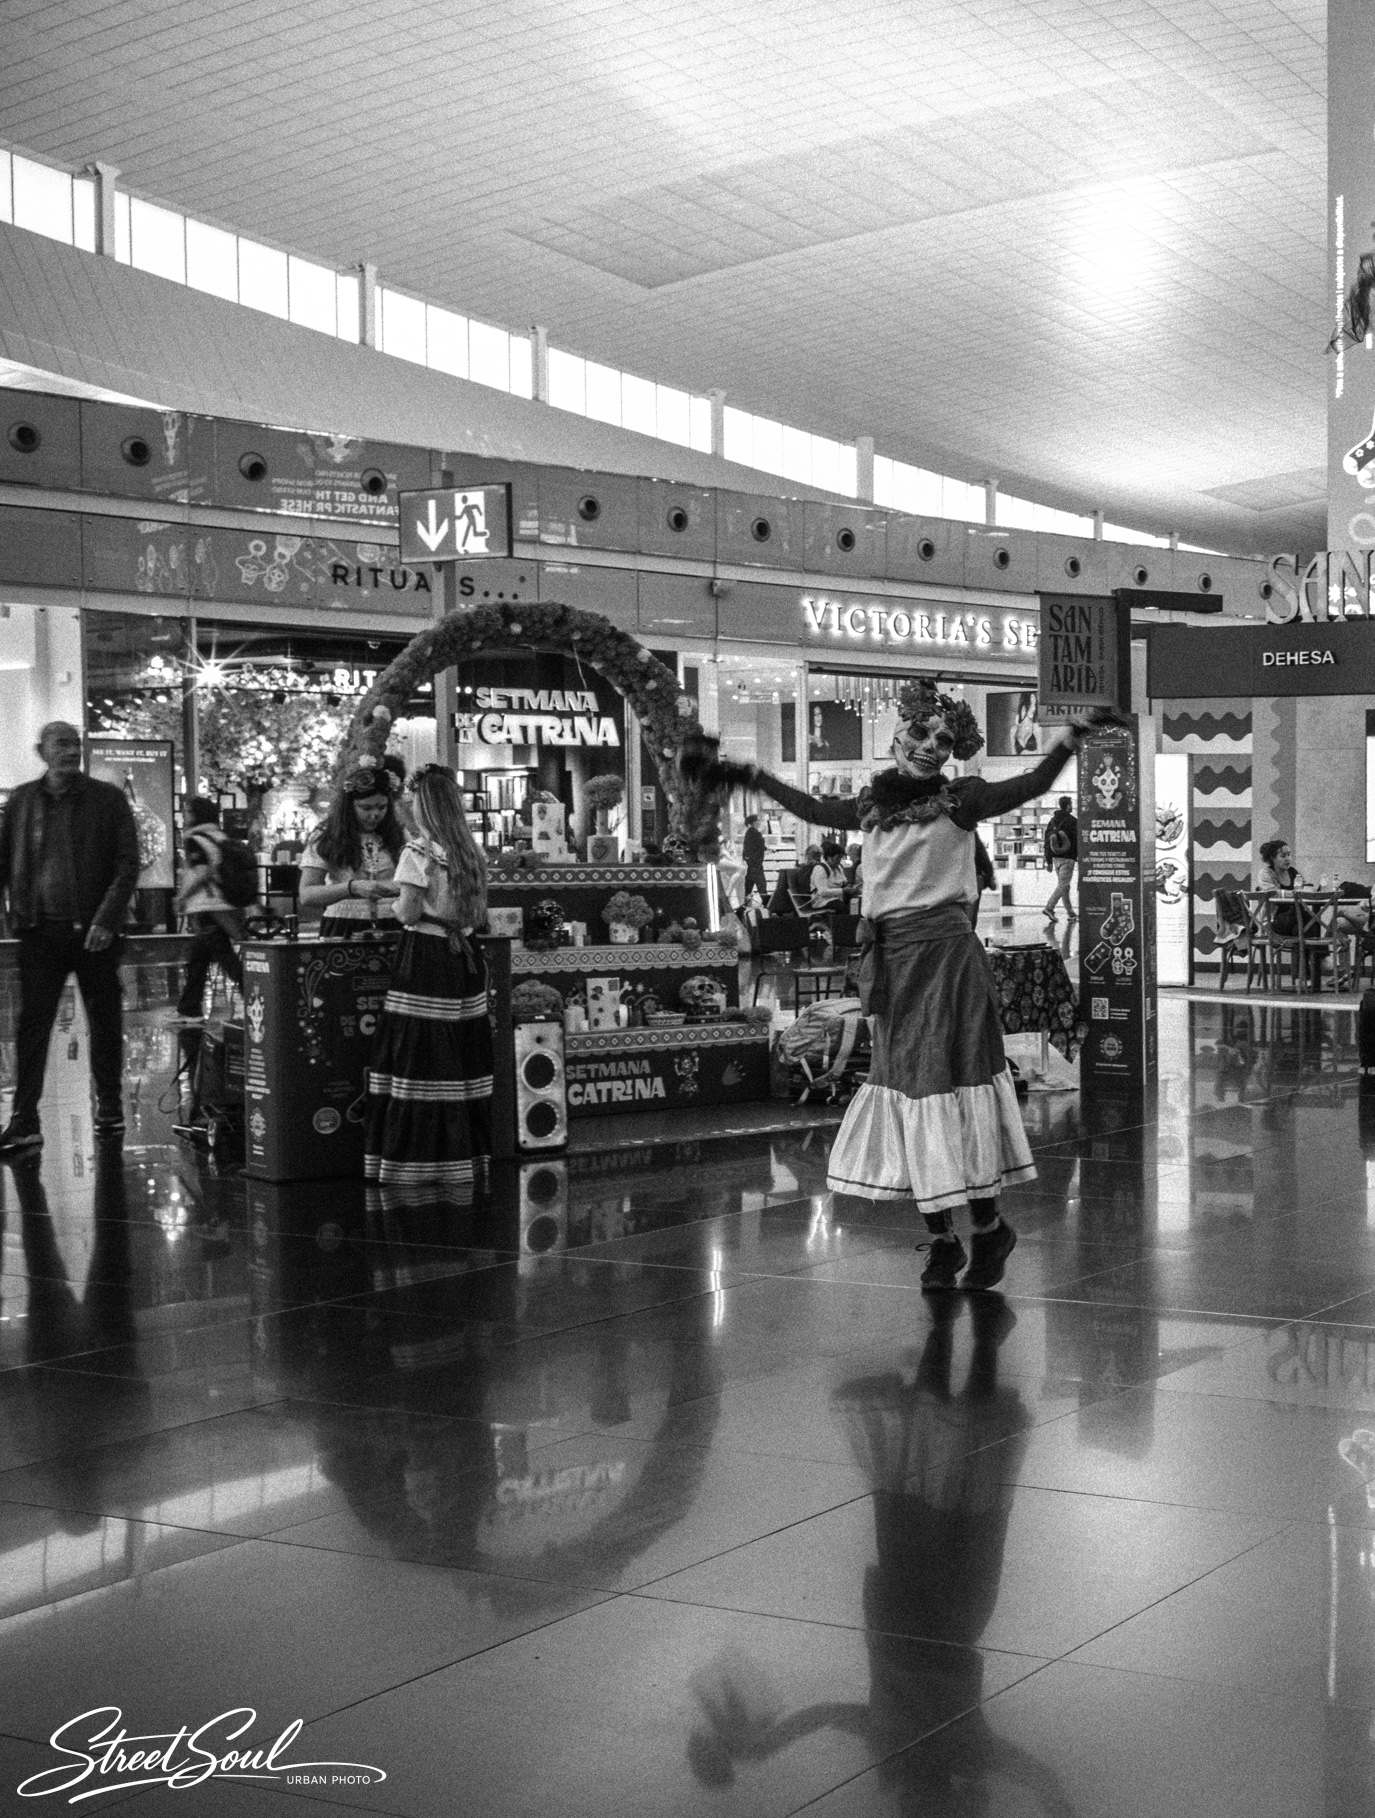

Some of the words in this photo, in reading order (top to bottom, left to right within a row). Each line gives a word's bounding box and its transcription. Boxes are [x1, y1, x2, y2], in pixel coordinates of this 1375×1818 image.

[806, 600, 992, 644] VICTORIA'S
[1048, 604, 1093, 633] SAN
[1048, 634, 1093, 664] TAM
[1262, 650, 1335, 666] DEHESA
[476, 686, 600, 712] SETMANA
[480, 713, 620, 747] CATRINA
[1089, 829, 1137, 843] CATRINA
[1091, 819, 1126, 829] SEMANA
[566, 1059, 651, 1081] SETMANA
[568, 1076, 666, 1106] CATRINA
